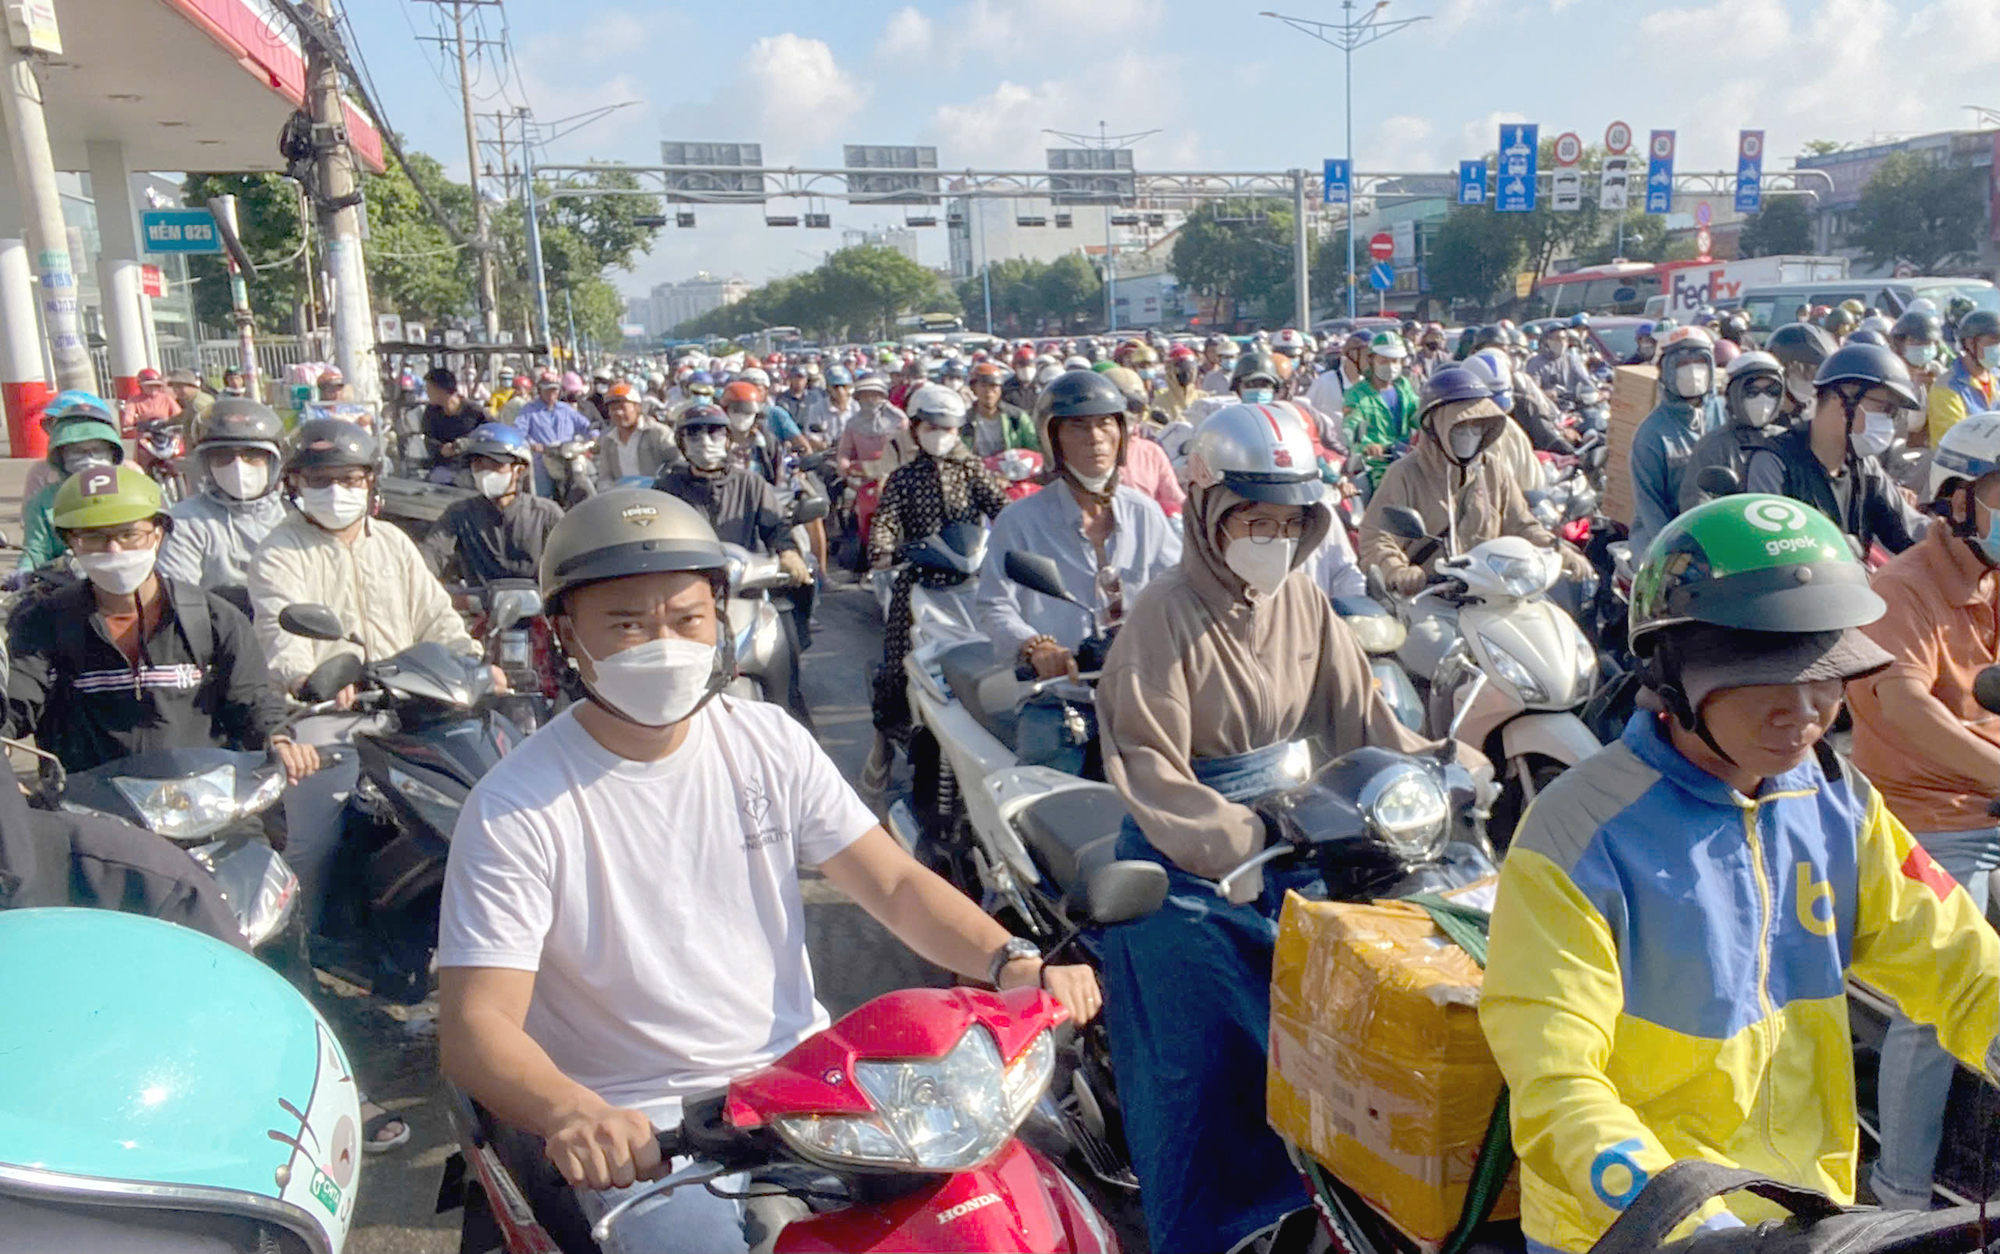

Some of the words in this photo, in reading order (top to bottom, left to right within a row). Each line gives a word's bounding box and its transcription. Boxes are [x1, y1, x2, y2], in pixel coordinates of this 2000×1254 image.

[184, 224, 212, 241] 825
[1673, 270, 1741, 310] FedEx
[1765, 535, 1818, 556] gojek
[323, 1180, 340, 1205] CHITA
[936, 1193, 1002, 1224] HONDA
